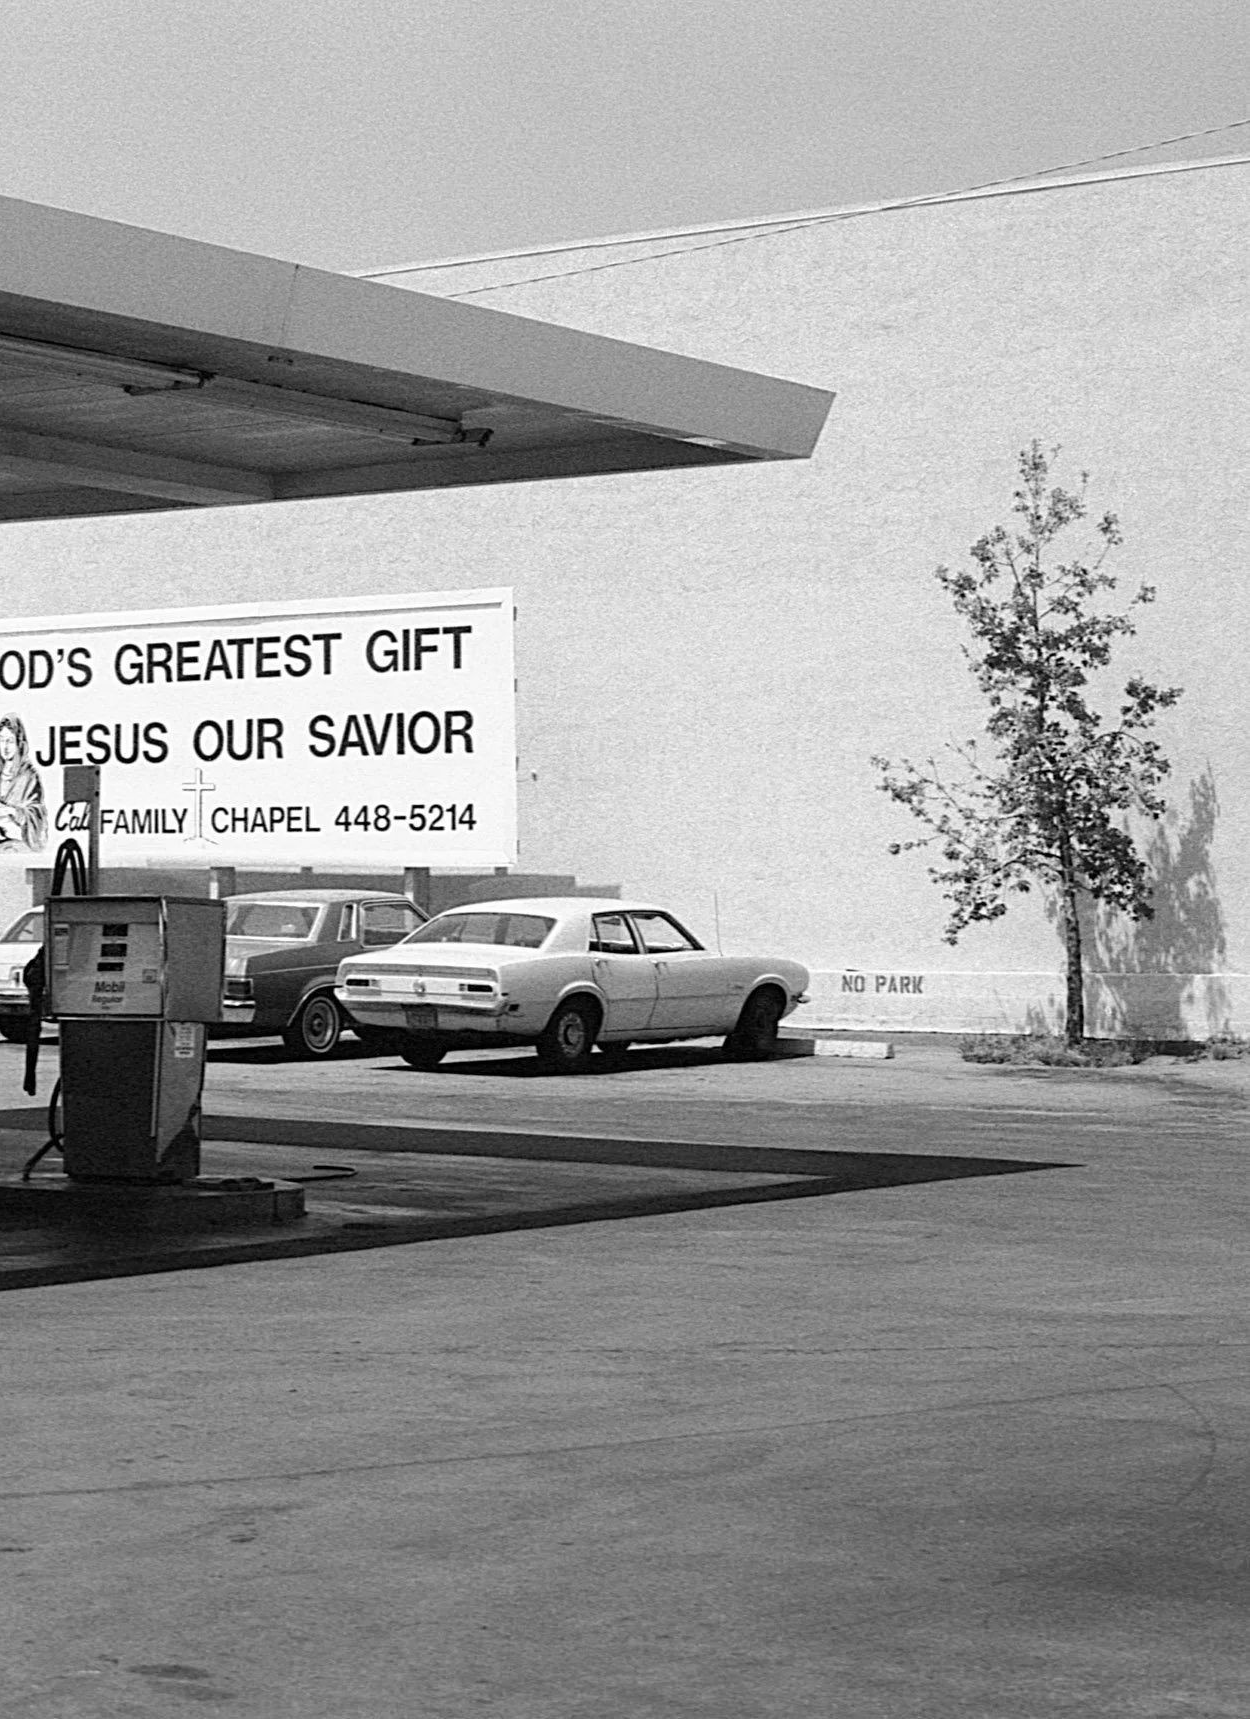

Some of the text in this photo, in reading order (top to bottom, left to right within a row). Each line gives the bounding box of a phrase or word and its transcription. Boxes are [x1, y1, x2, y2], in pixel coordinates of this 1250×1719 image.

[114, 632, 343, 686] GREATEST
[365, 625, 473, 674] GIFT
[35, 710, 474, 767] JESUS OUR SAVIOR
[100, 808, 188, 835] FAMILY
[210, 806, 321, 834] CHAPEL
[334, 803, 477, 832] 448-5214
[94, 980, 126, 993] Mobil
[841, 975, 924, 994] NO PARK
